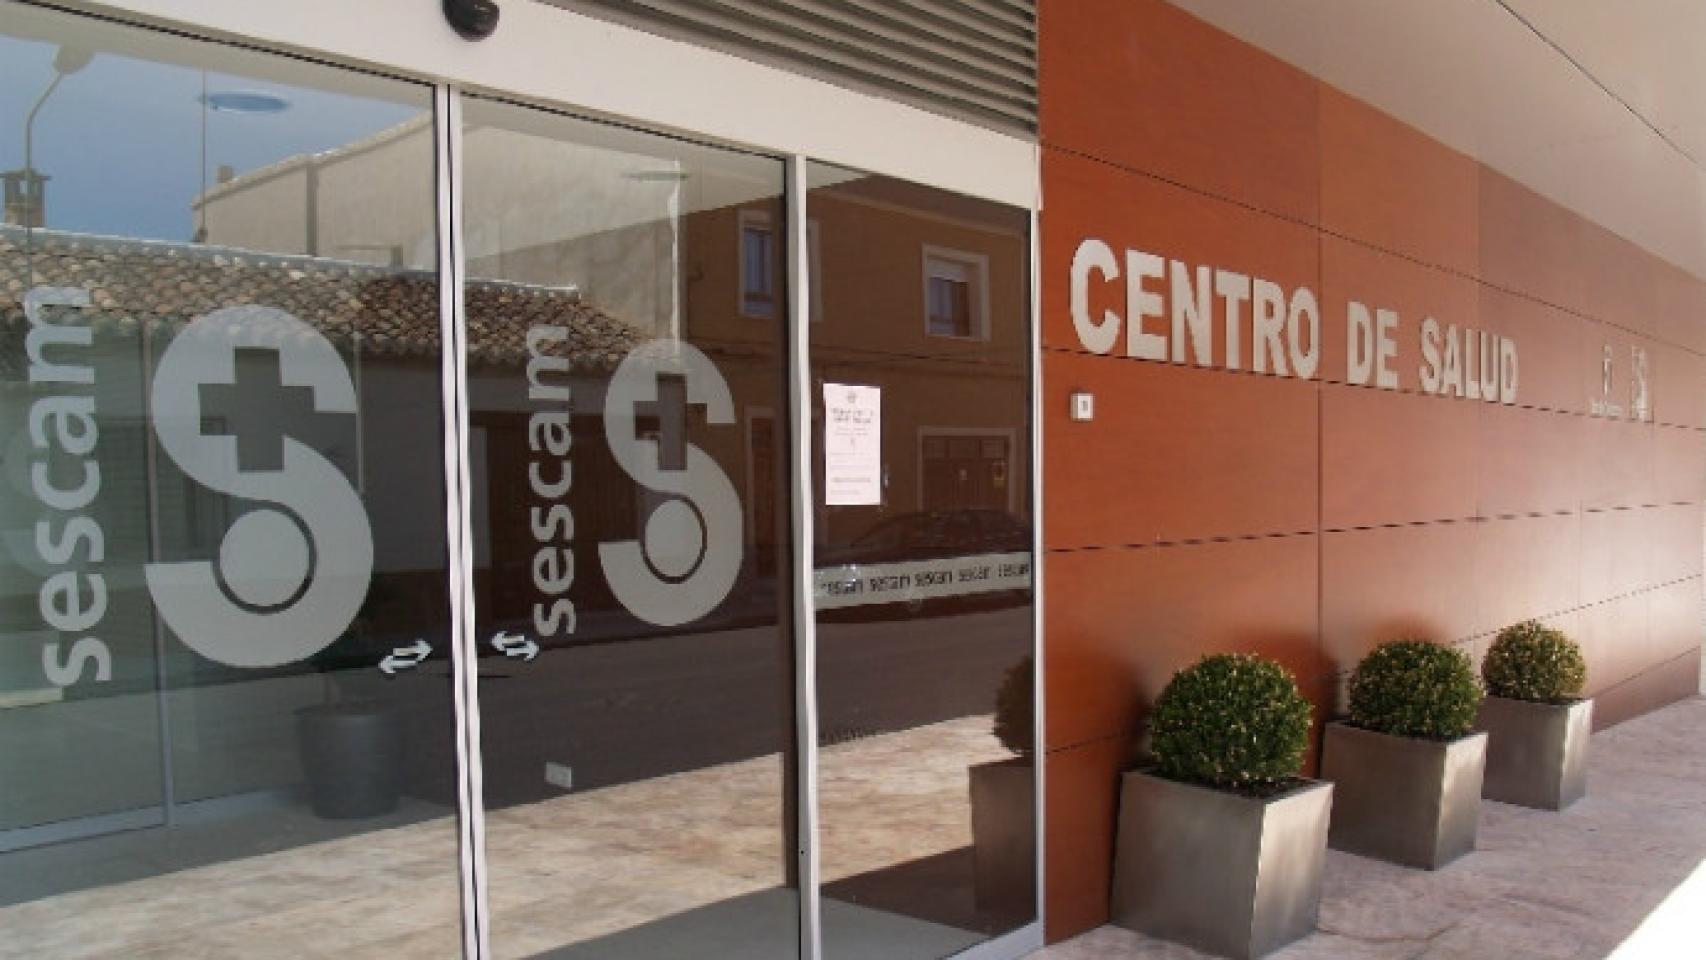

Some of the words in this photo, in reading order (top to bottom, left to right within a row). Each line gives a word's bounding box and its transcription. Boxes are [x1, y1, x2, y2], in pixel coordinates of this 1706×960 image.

[1070, 238, 1320, 379] CENTRO
[1347, 301, 1399, 390] DE
[1419, 316, 1518, 404] SALUD
[25, 286, 111, 686] sescam
[525, 323, 576, 636] sescam
